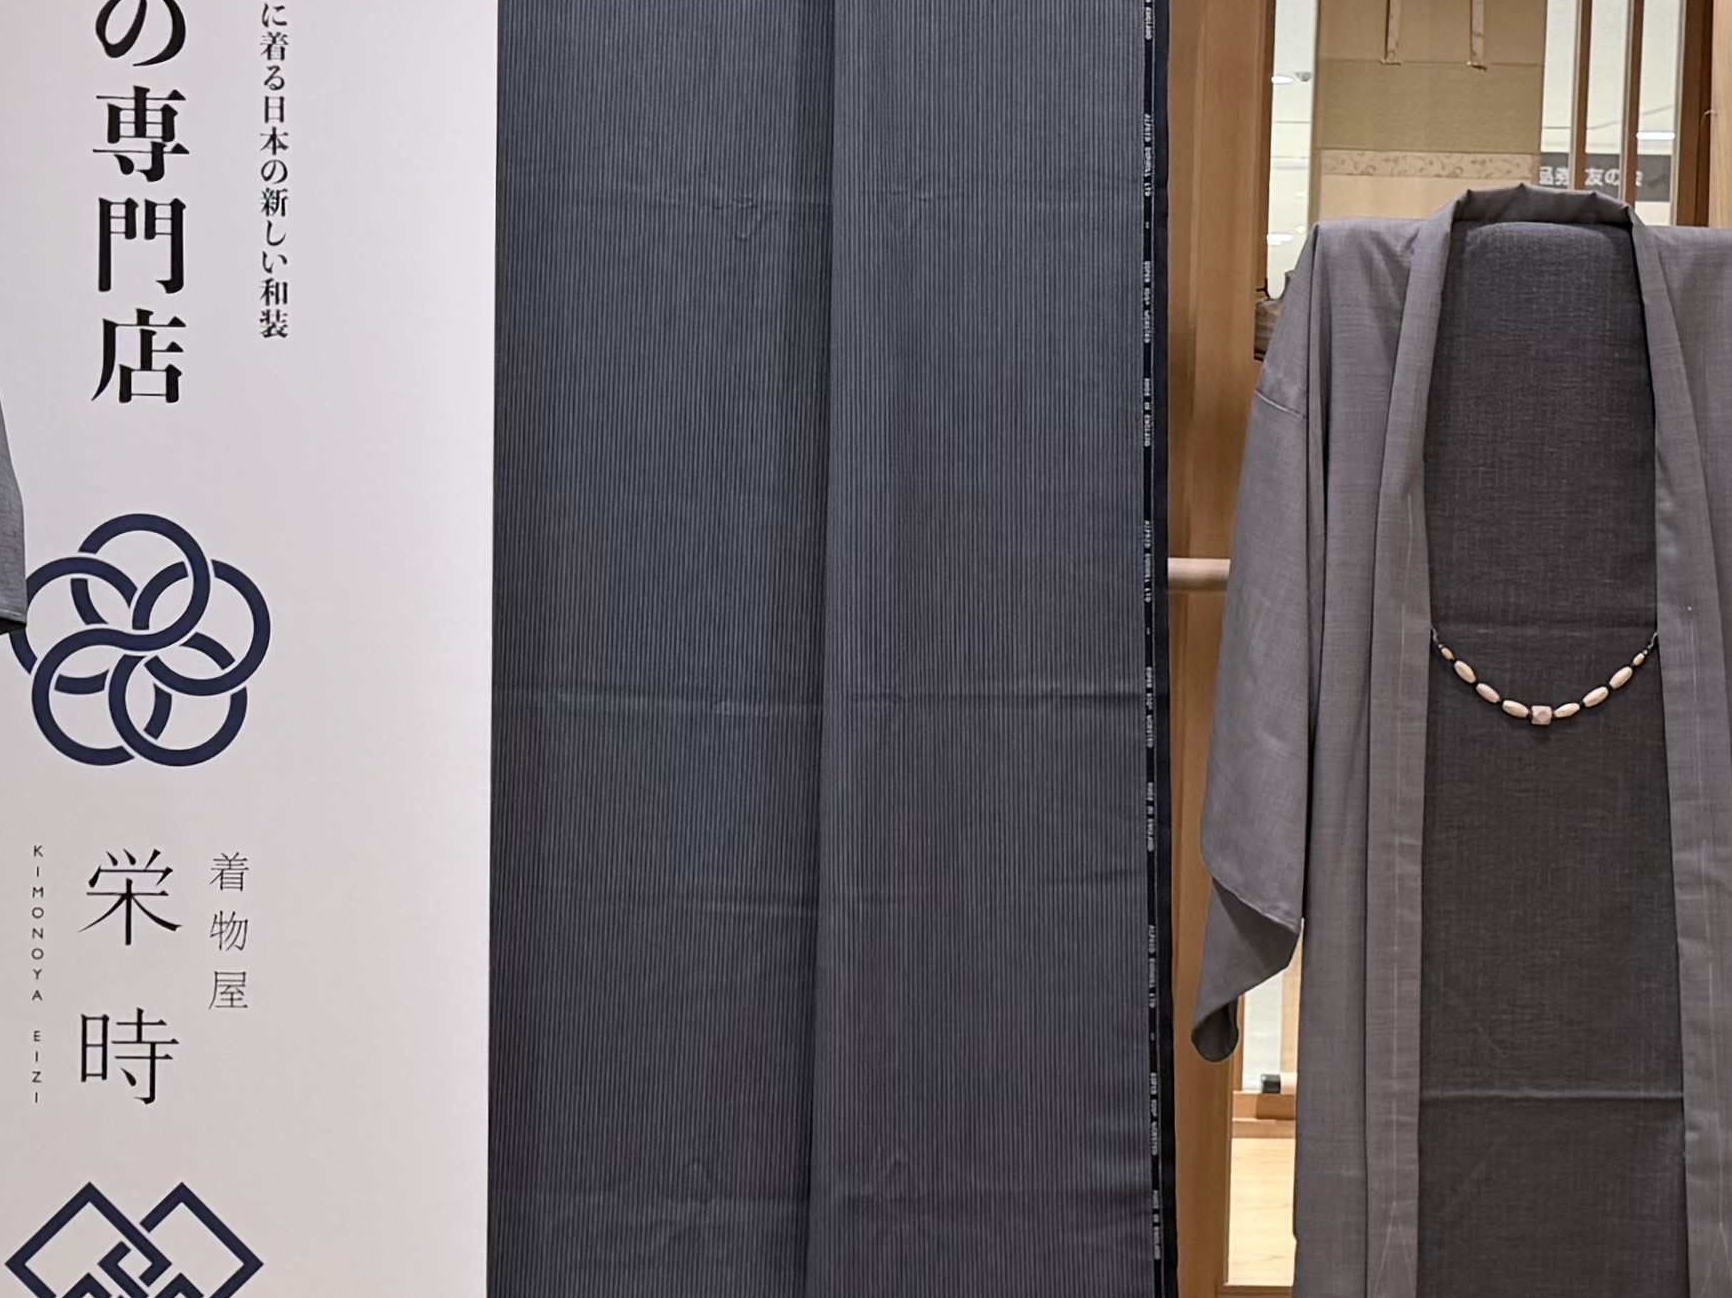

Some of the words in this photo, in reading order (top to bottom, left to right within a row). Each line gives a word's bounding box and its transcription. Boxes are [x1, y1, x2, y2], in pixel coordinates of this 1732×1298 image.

[31, 845, 44, 1001] KIMONOYA
[77, 847, 183, 1105] 栄時
[208, 851, 250, 1010] 着物屋
[31, 1030, 42, 1103] EIZI
